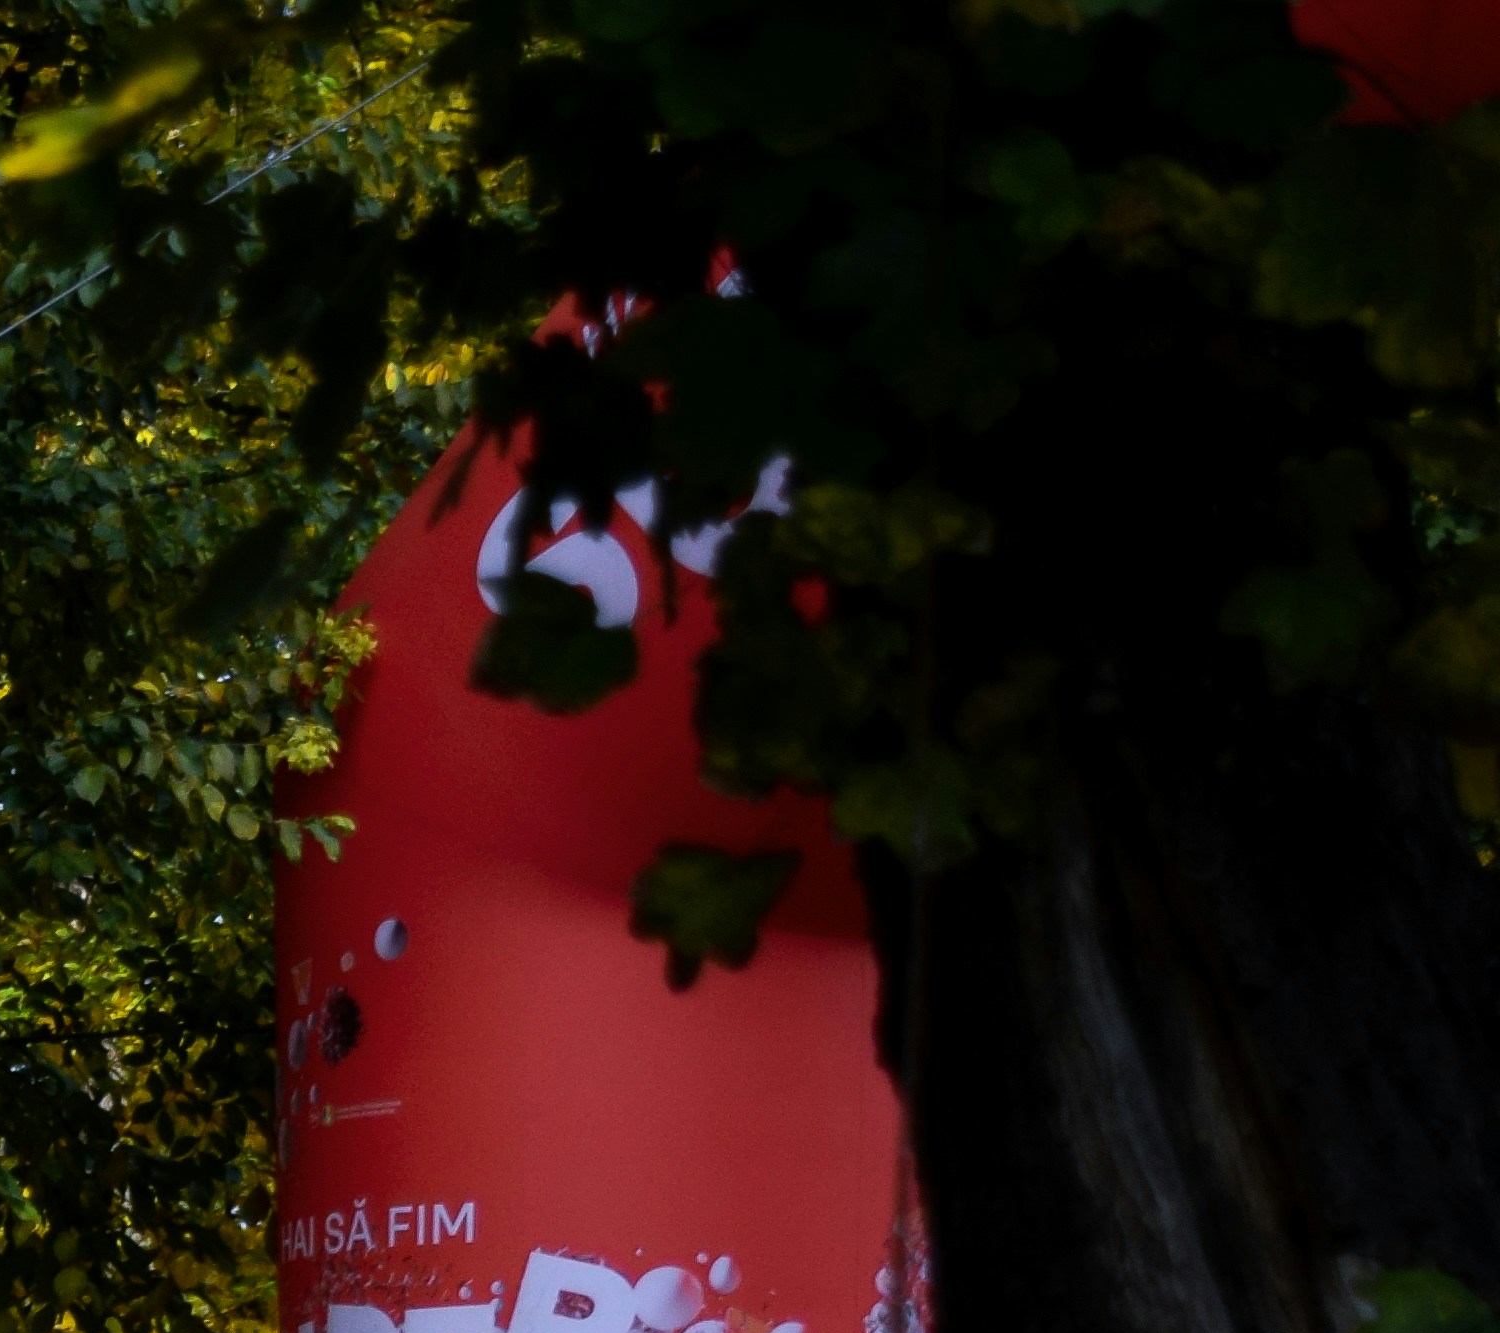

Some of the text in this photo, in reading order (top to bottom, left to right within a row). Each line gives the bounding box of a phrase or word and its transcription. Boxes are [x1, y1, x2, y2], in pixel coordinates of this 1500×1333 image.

[281, 1198, 476, 1262] HAI SĂ FIM
